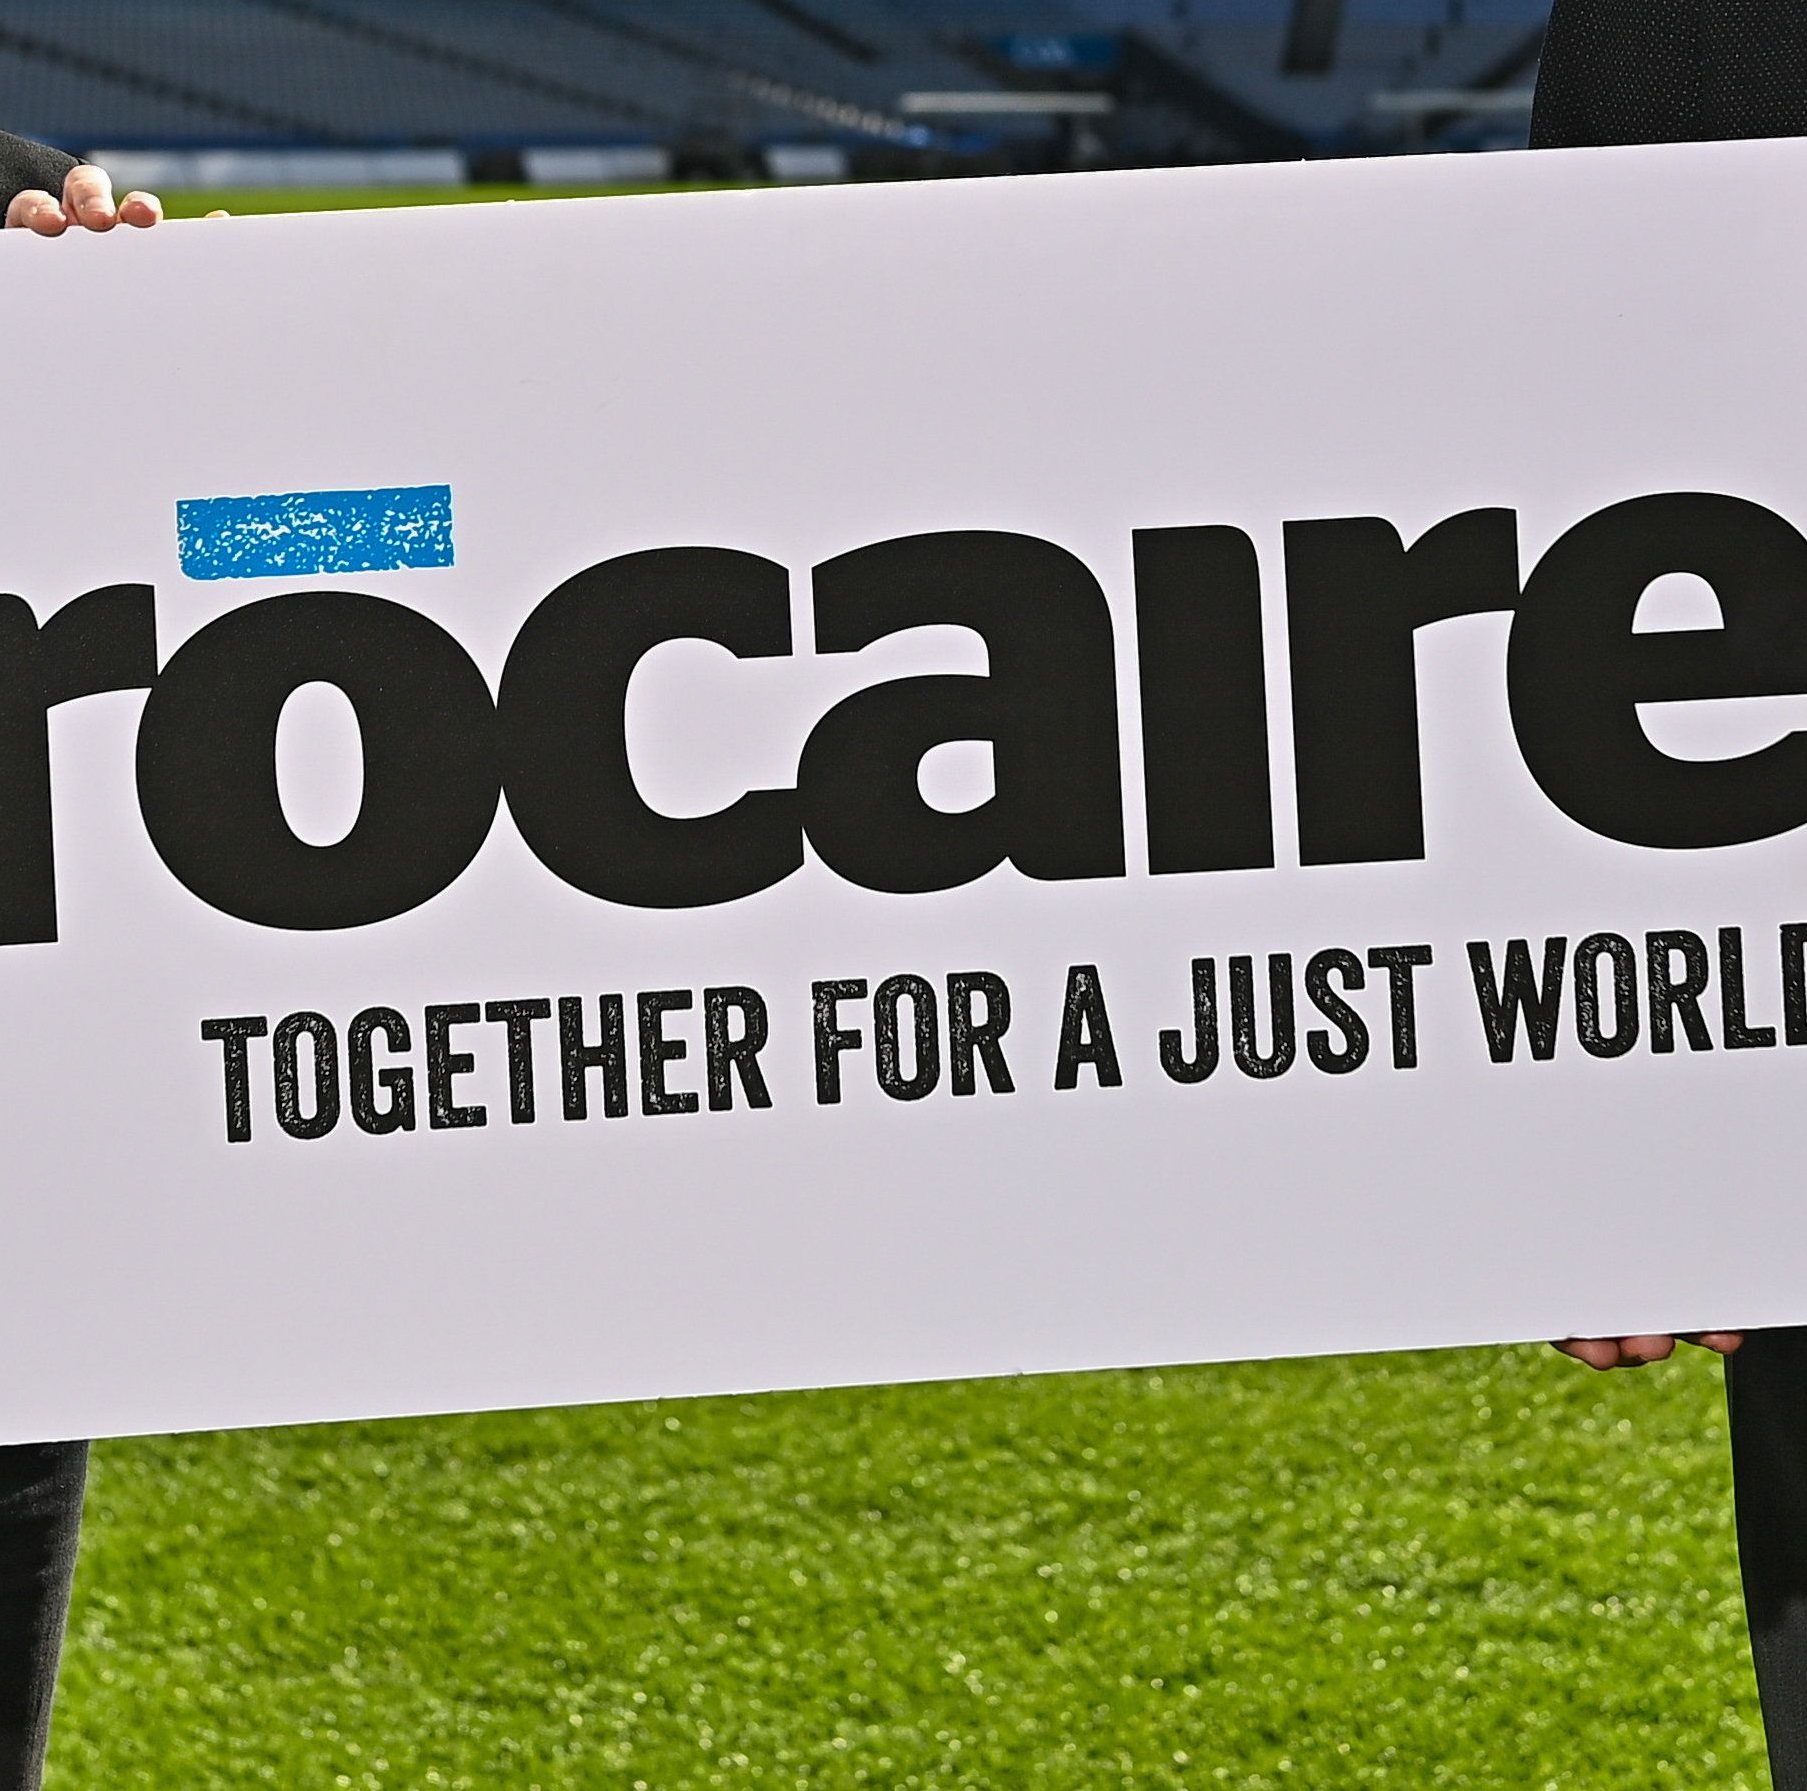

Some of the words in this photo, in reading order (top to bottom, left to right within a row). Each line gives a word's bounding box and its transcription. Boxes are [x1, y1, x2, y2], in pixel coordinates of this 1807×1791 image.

[201, 986, 772, 1143] TOGETHER
[812, 972, 1015, 1104] FOR
[1055, 965, 1122, 1090] A
[1159, 945, 1432, 1085] JUST
